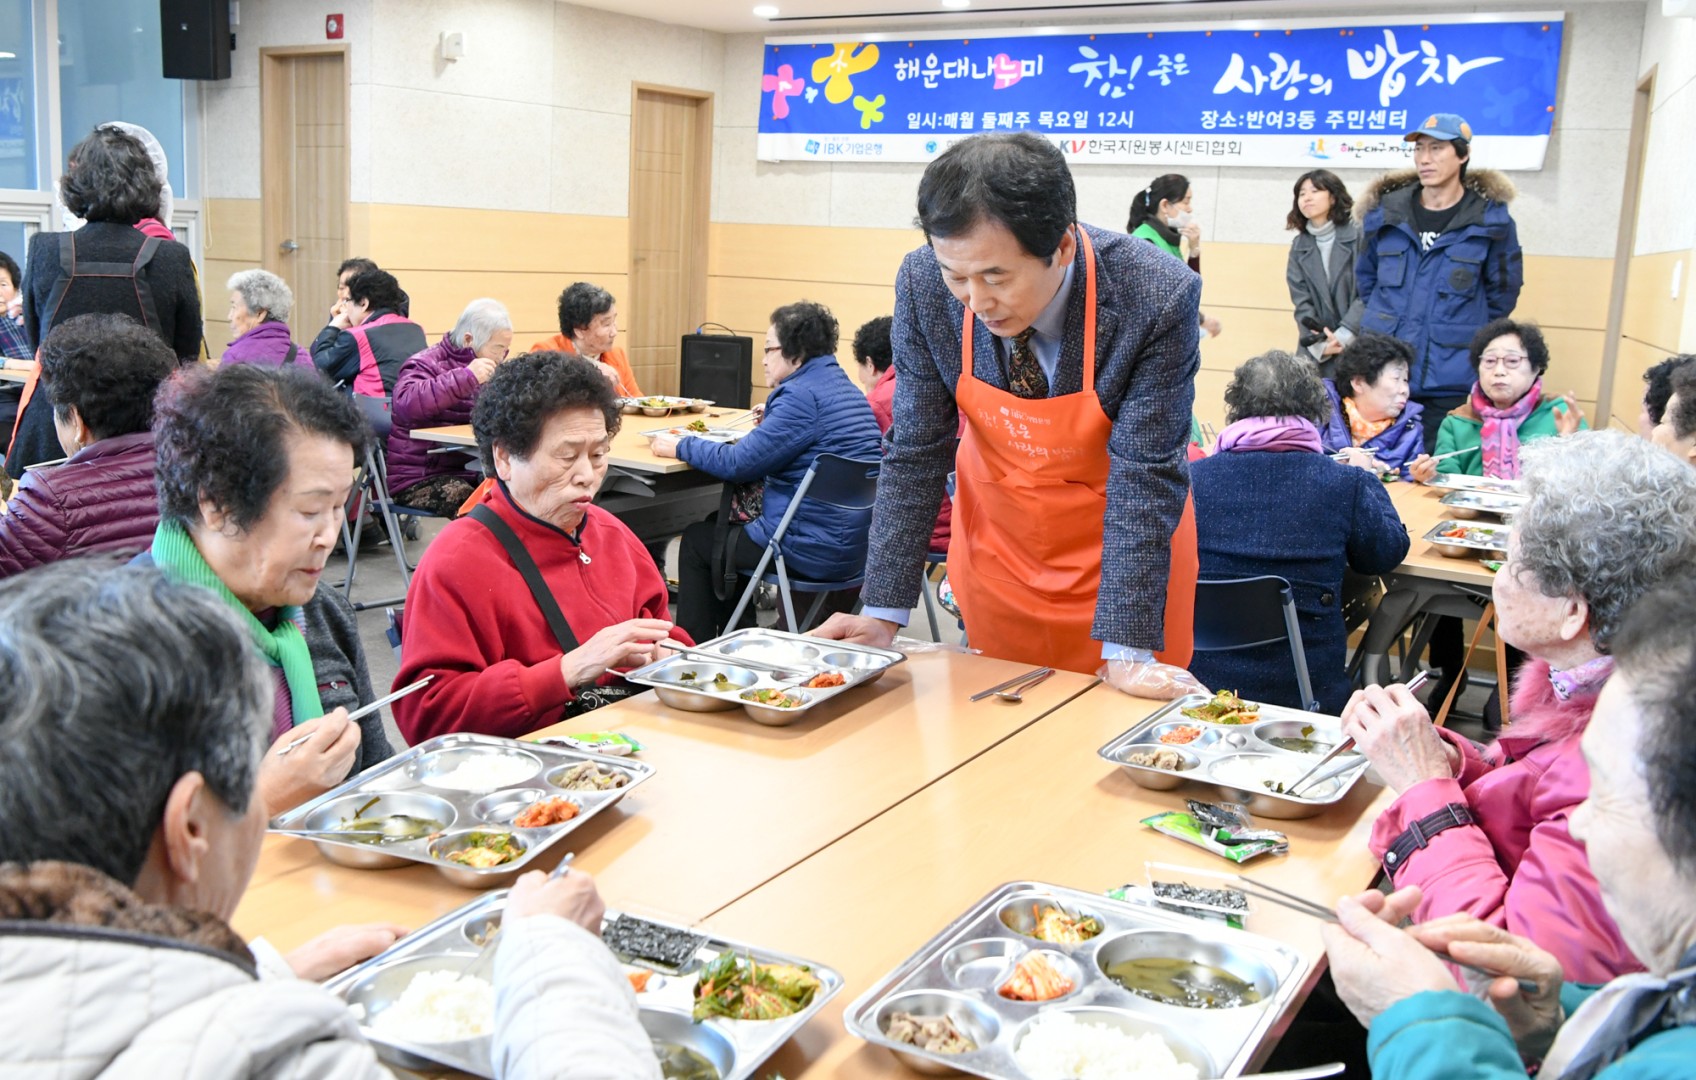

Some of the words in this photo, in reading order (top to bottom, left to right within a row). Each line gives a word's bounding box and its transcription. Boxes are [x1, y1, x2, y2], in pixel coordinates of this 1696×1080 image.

[894, 52, 1044, 89] 해운대나누미
[1067, 45, 1143, 99] 참!
[1147, 53, 1190, 86] 좋은
[1212, 52, 1332, 101] 사랑의
[1346, 29, 1505, 107] 밥차
[907, 111, 975, 129] 일시:매월
[981, 111, 1031, 129] 둘째주
[1038, 110, 1088, 129] 목요일
[1097, 110, 1134, 129] 12시
[1201, 109, 1316, 129] 장소:반여3동
[1325, 109, 1408, 129] 주민센터
